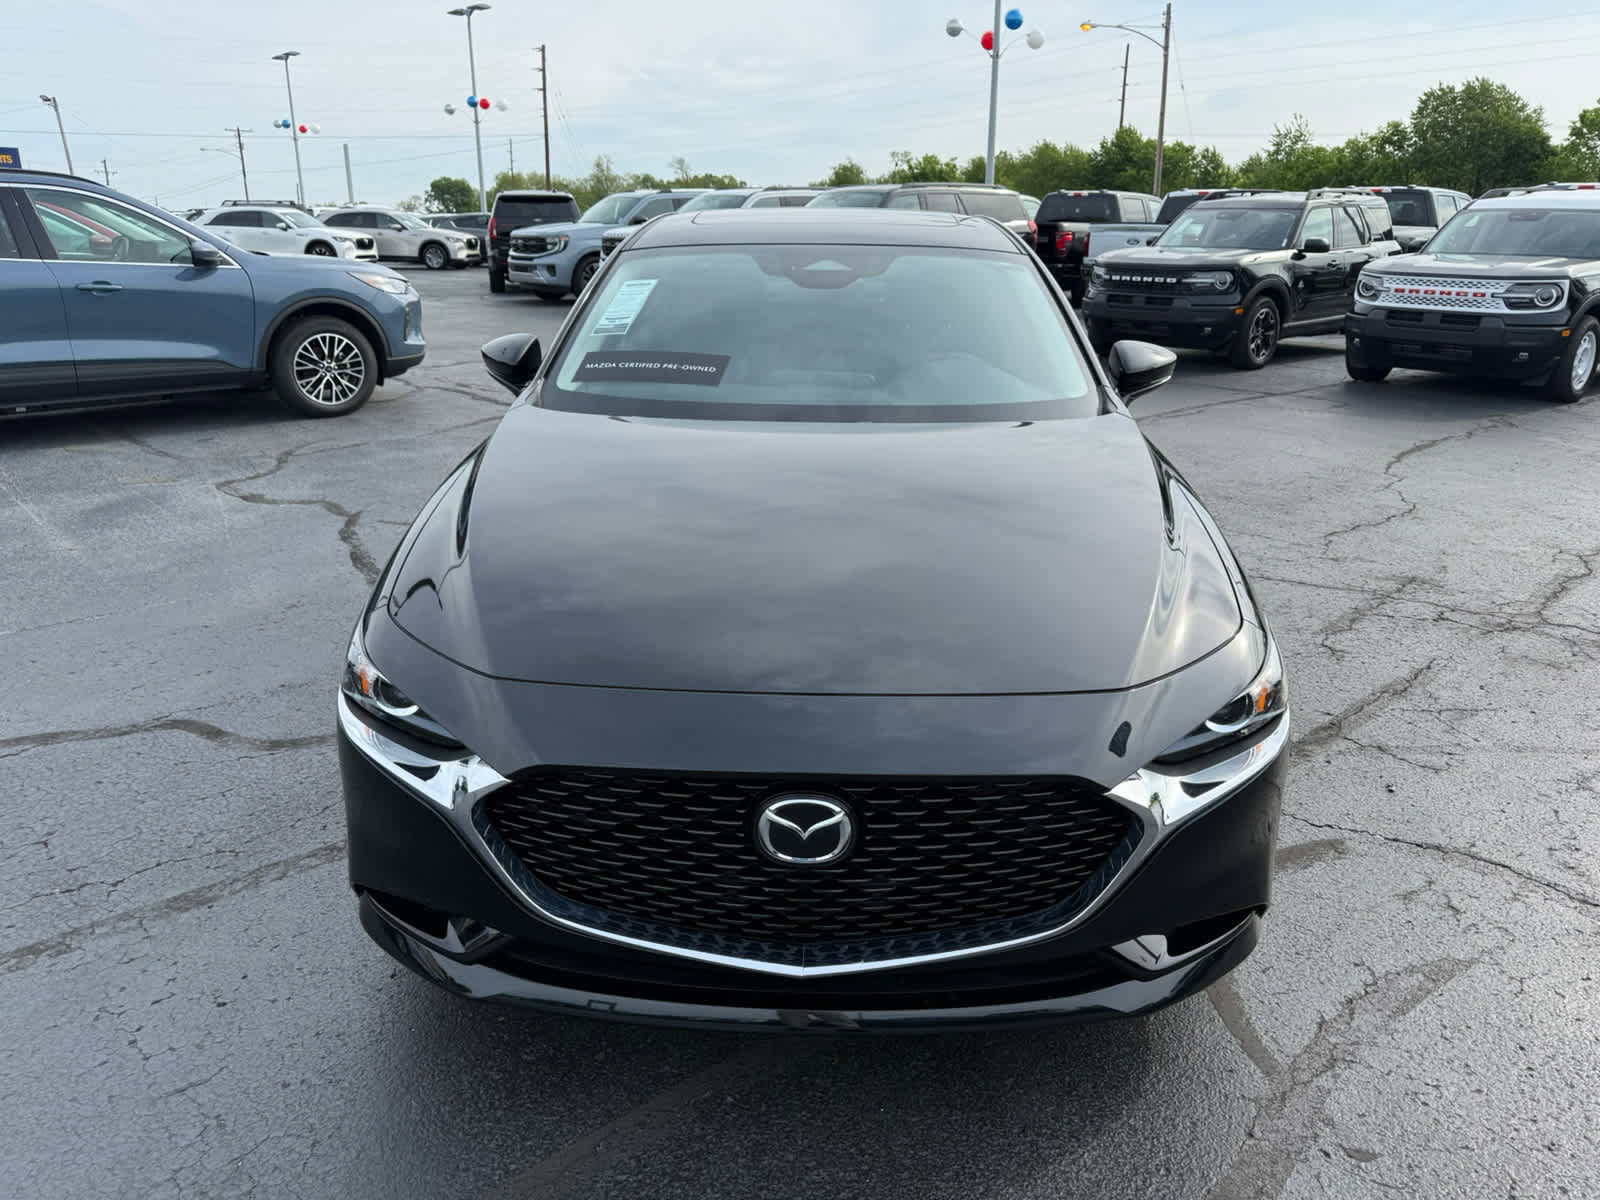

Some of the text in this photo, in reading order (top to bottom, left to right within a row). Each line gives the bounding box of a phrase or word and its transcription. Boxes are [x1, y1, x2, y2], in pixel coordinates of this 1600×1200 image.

[1111, 275, 1177, 283] BRONCO
[1394, 287, 1486, 298] BRONCO
[618, 361, 661, 369] CERTIFIED
[662, 363, 717, 373] PRE-OWNED
